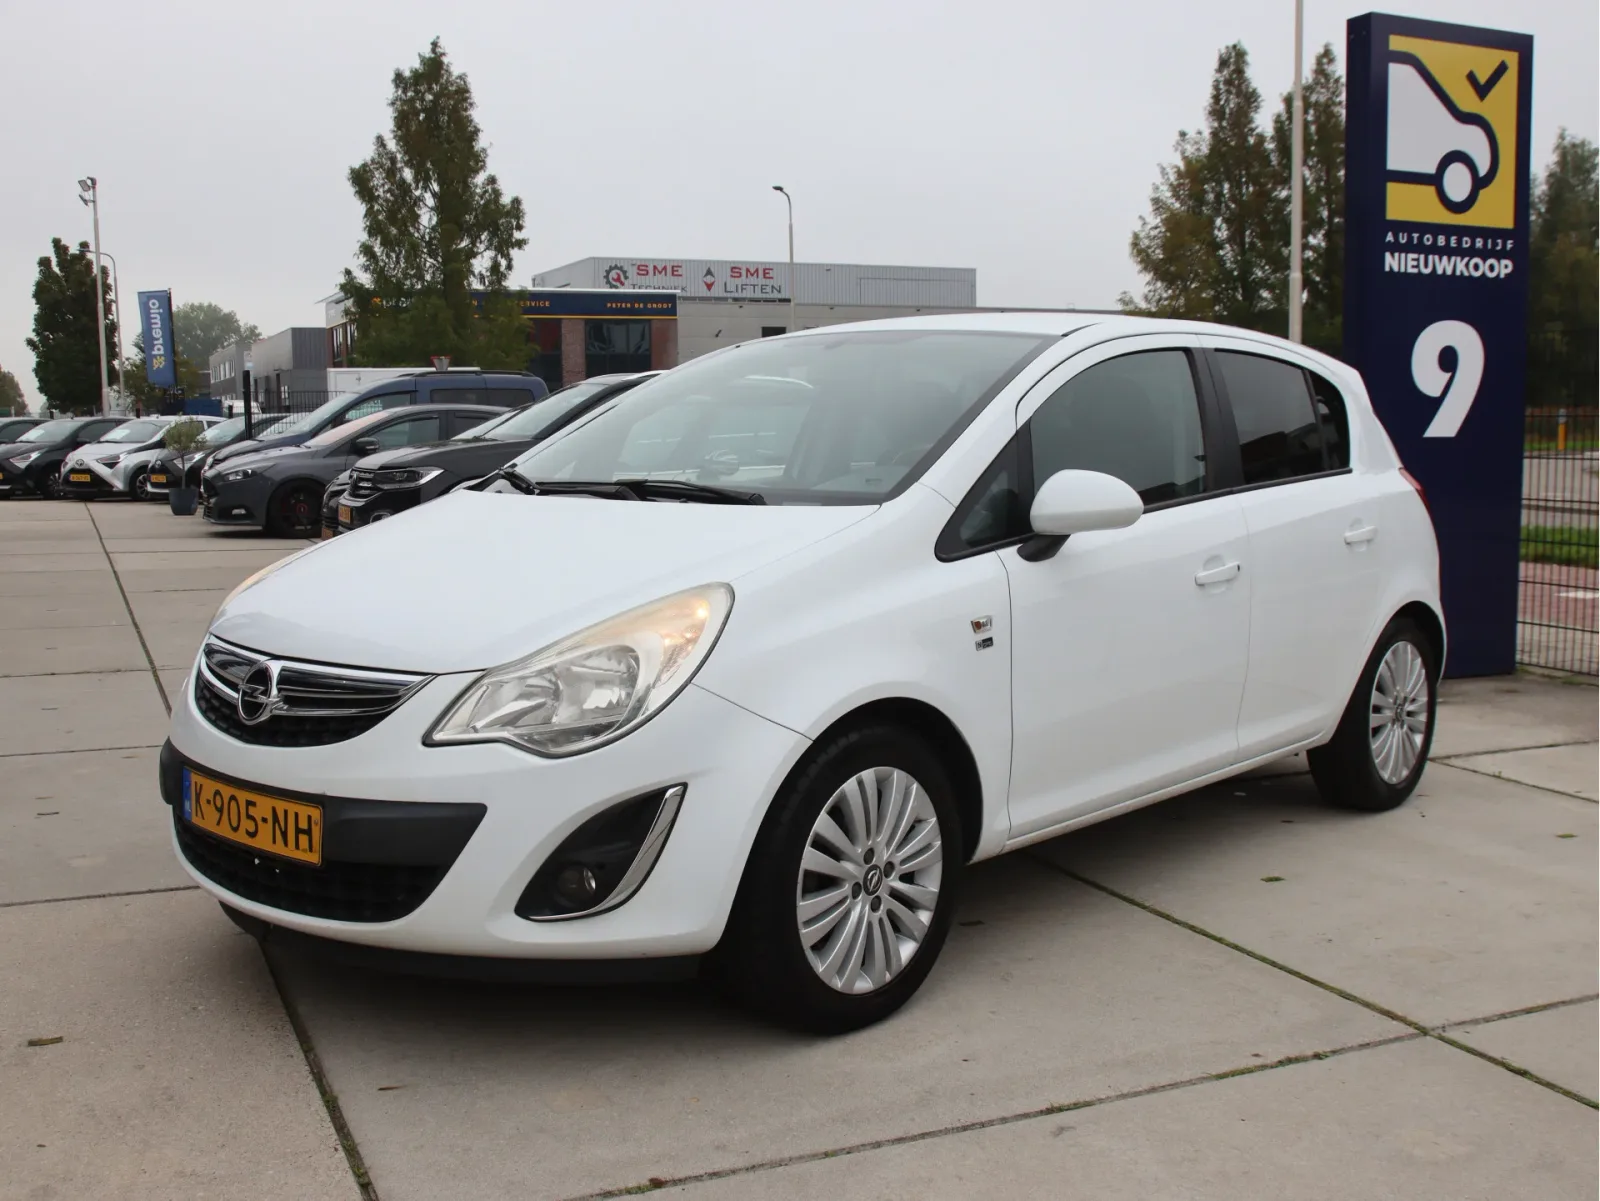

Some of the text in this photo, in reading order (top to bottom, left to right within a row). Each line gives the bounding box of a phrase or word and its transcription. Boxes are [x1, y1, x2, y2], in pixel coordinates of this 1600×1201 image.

[1385, 231, 1514, 251] AUTOBEDRIJF
[636, 264, 683, 277] SME
[730, 266, 774, 280] SME
[1384, 251, 1514, 279] NIEUWKOOP
[724, 281, 782, 294] LIFTEN
[149, 299, 164, 355] premio
[1411, 319, 1485, 438] 9
[194, 781, 313, 853] K-905-NH
